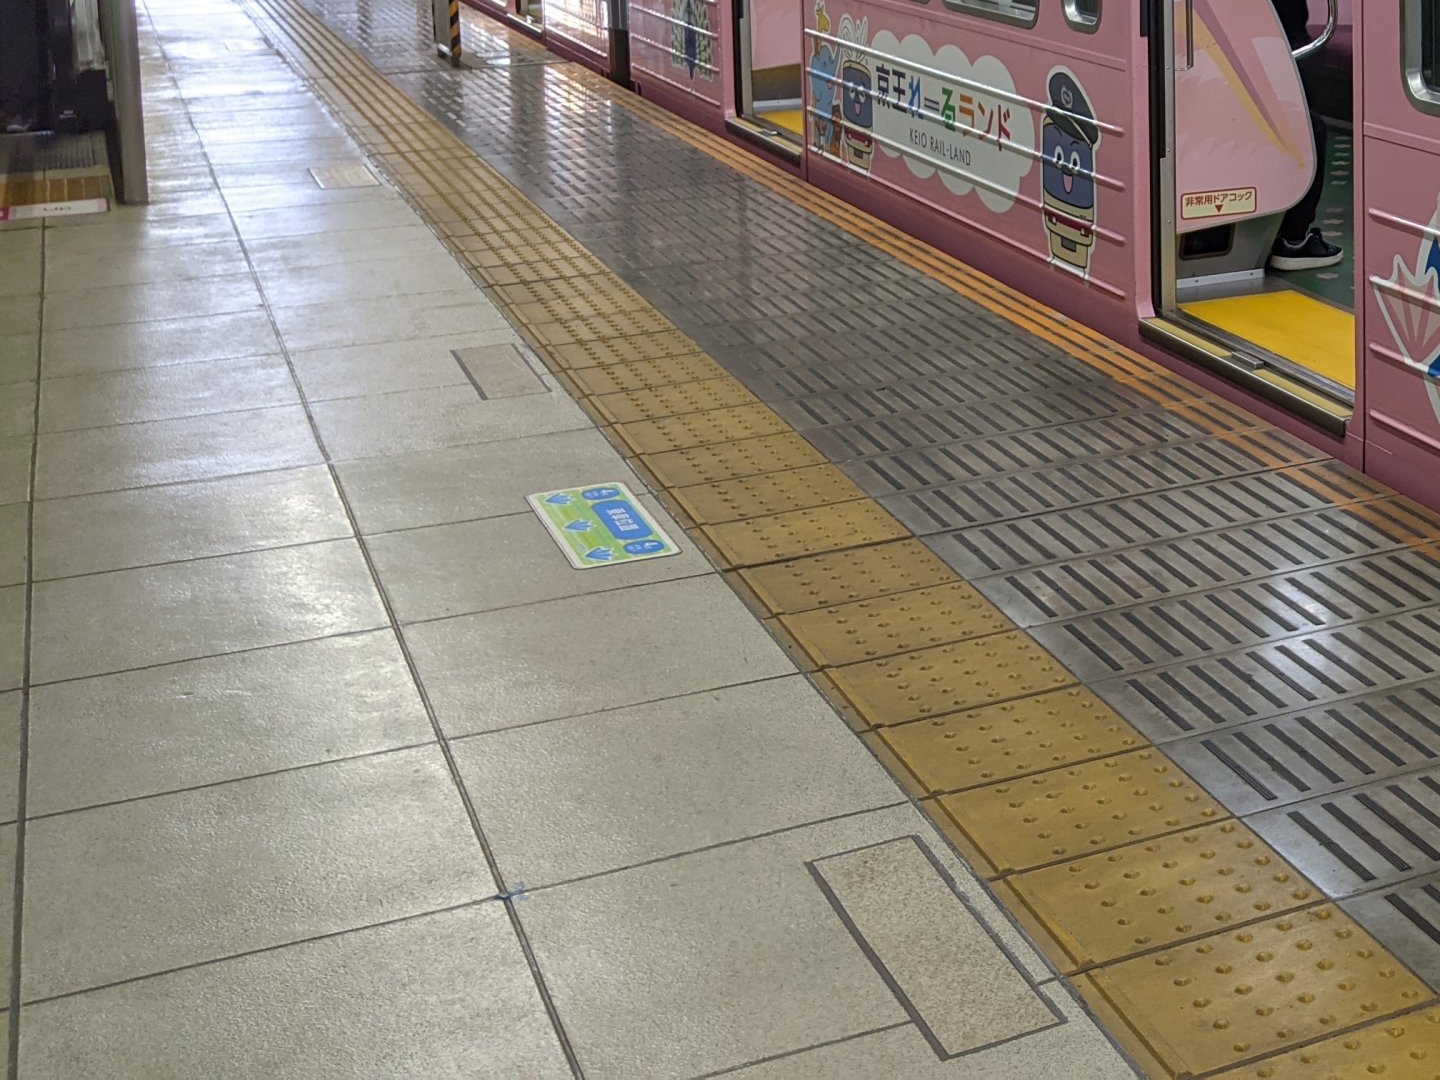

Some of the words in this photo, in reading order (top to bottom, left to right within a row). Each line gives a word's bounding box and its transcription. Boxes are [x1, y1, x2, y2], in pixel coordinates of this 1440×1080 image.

[910, 128, 927, 148] KEIO
[1186, 191, 1252, 207] 非常用ドアコック
